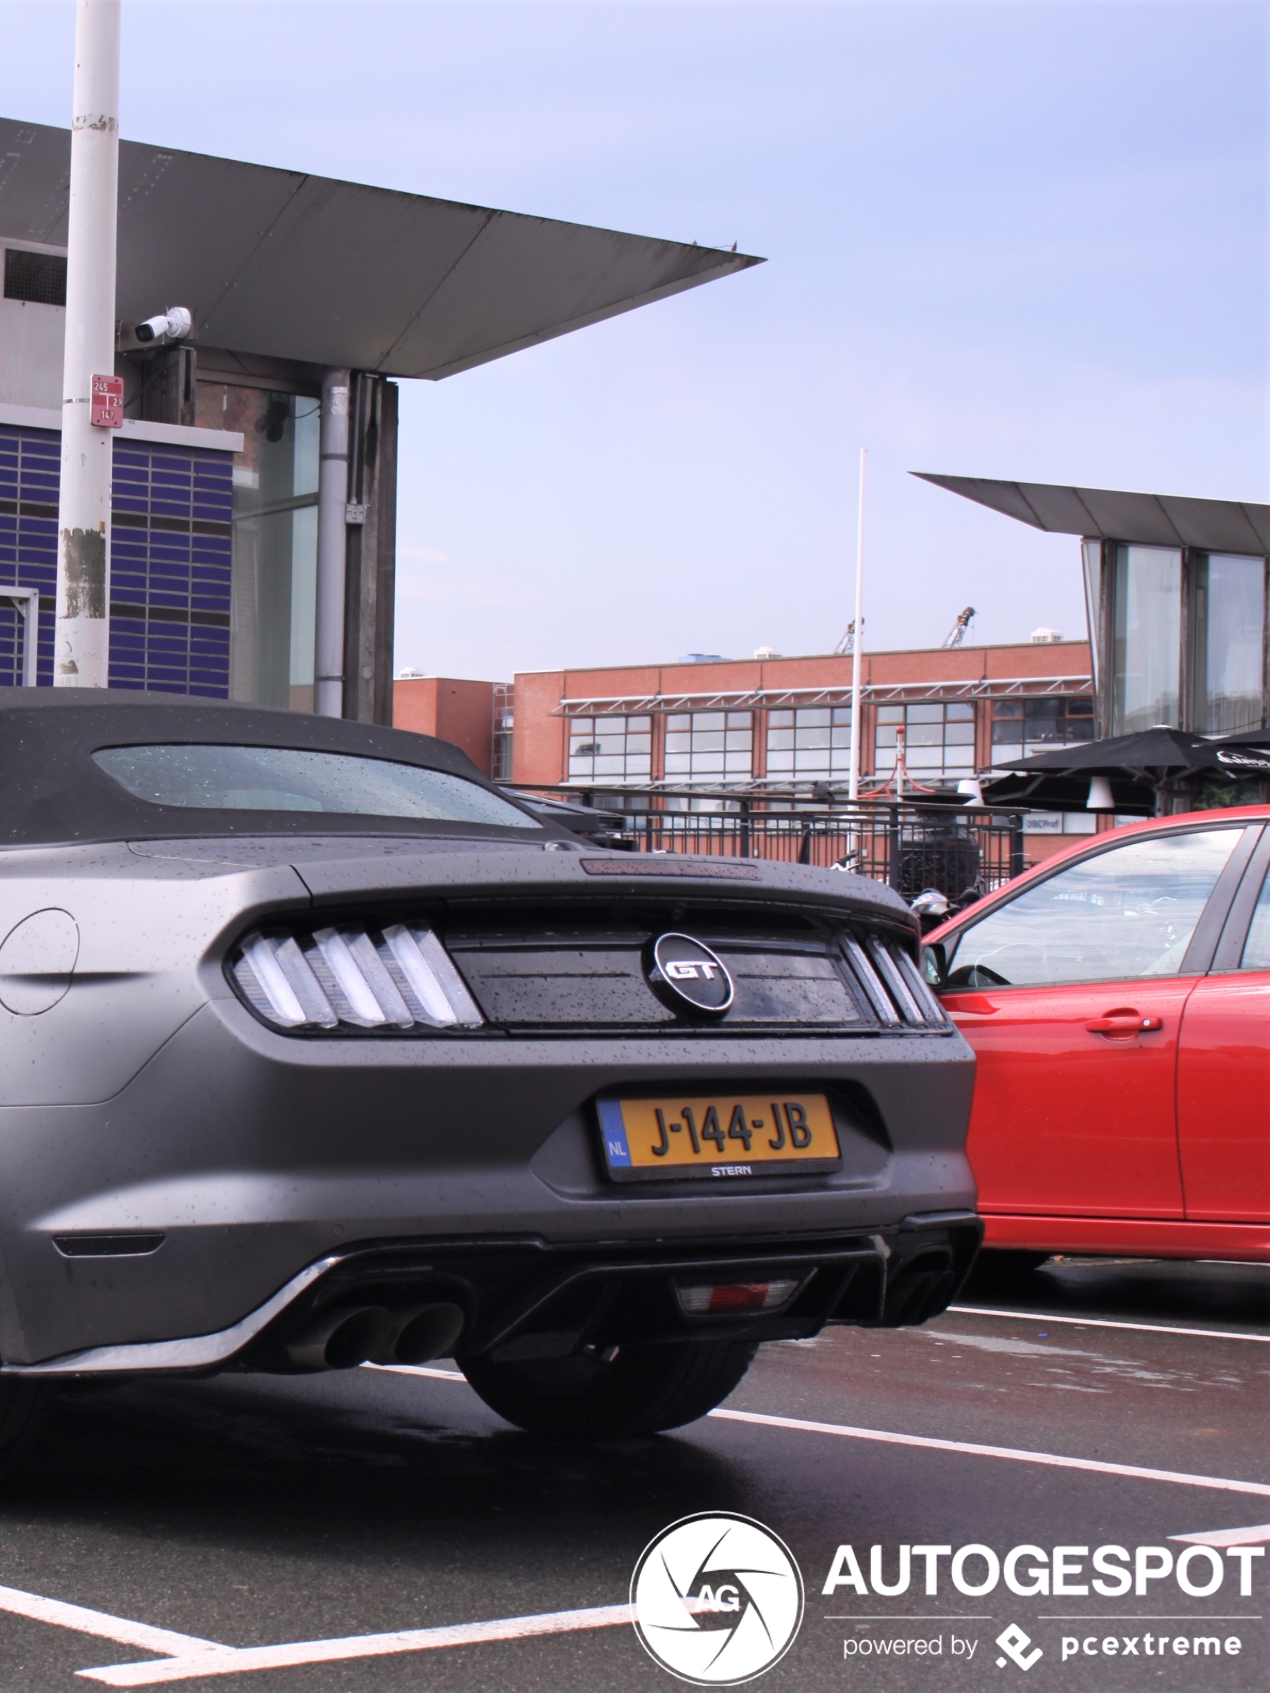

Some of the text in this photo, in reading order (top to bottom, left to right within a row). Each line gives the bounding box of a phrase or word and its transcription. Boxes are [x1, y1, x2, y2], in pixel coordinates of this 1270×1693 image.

[94, 382, 108, 392] 245
[664, 960, 719, 981] GT
[650, 1101, 813, 1157] J-144-JB
[608, 1141, 627, 1157] NL
[711, 1165, 753, 1177] STERN
